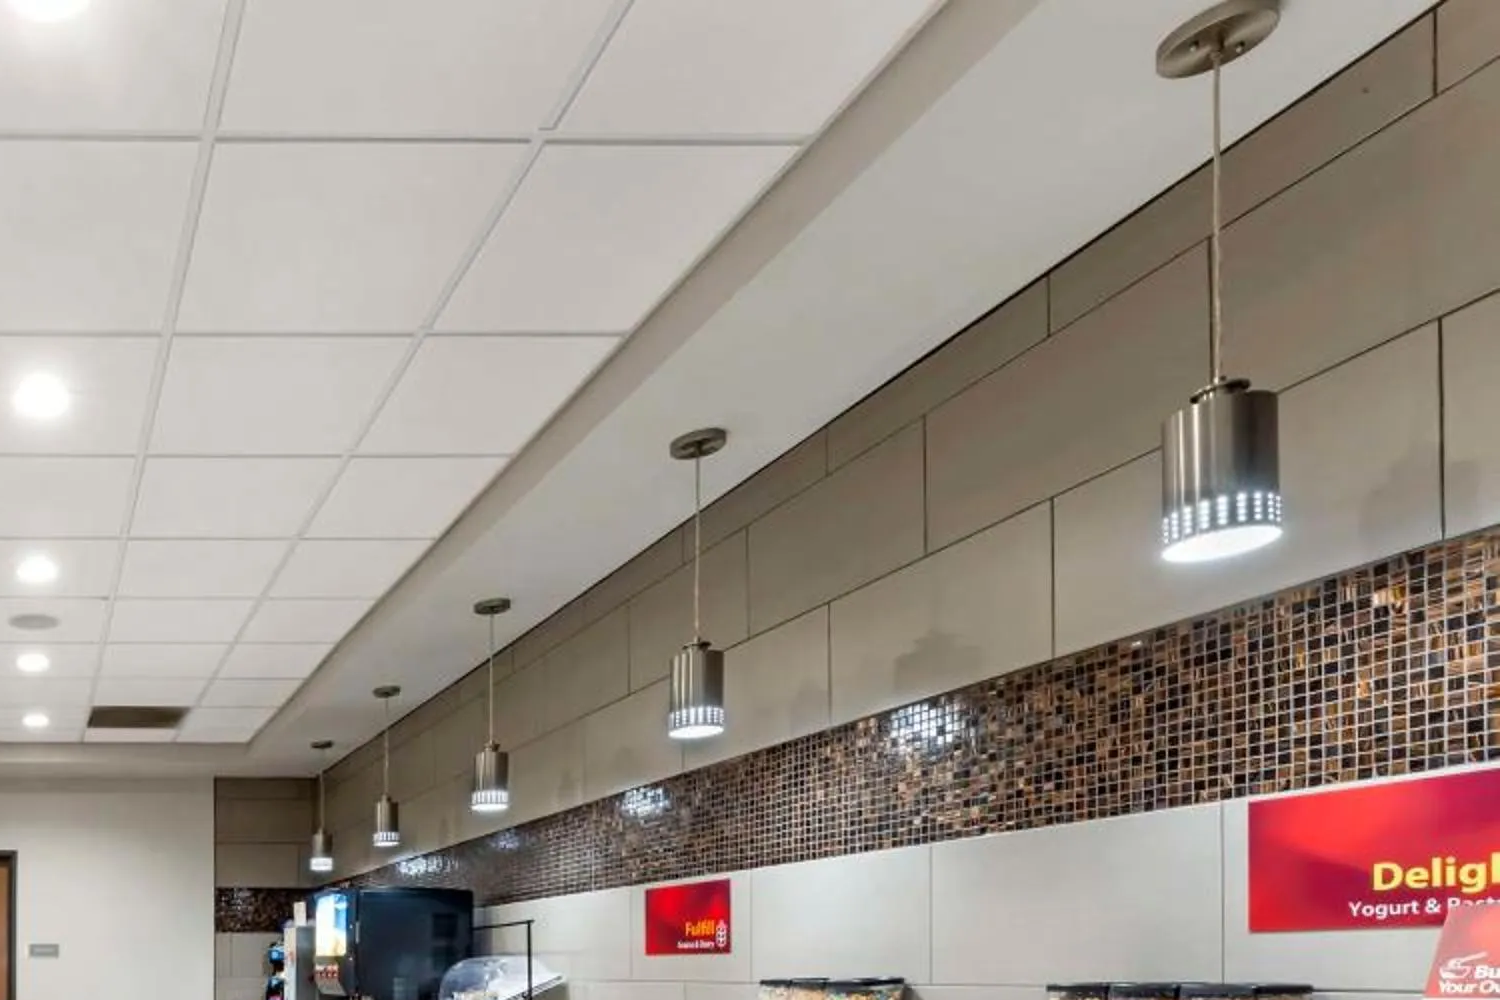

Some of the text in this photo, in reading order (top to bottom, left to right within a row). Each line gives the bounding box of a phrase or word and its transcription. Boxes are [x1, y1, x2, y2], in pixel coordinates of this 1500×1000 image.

[1348, 900, 1420, 920] Yogurt
[1425, 898, 1441, 914] &
[1439, 980, 1478, 994] Your
